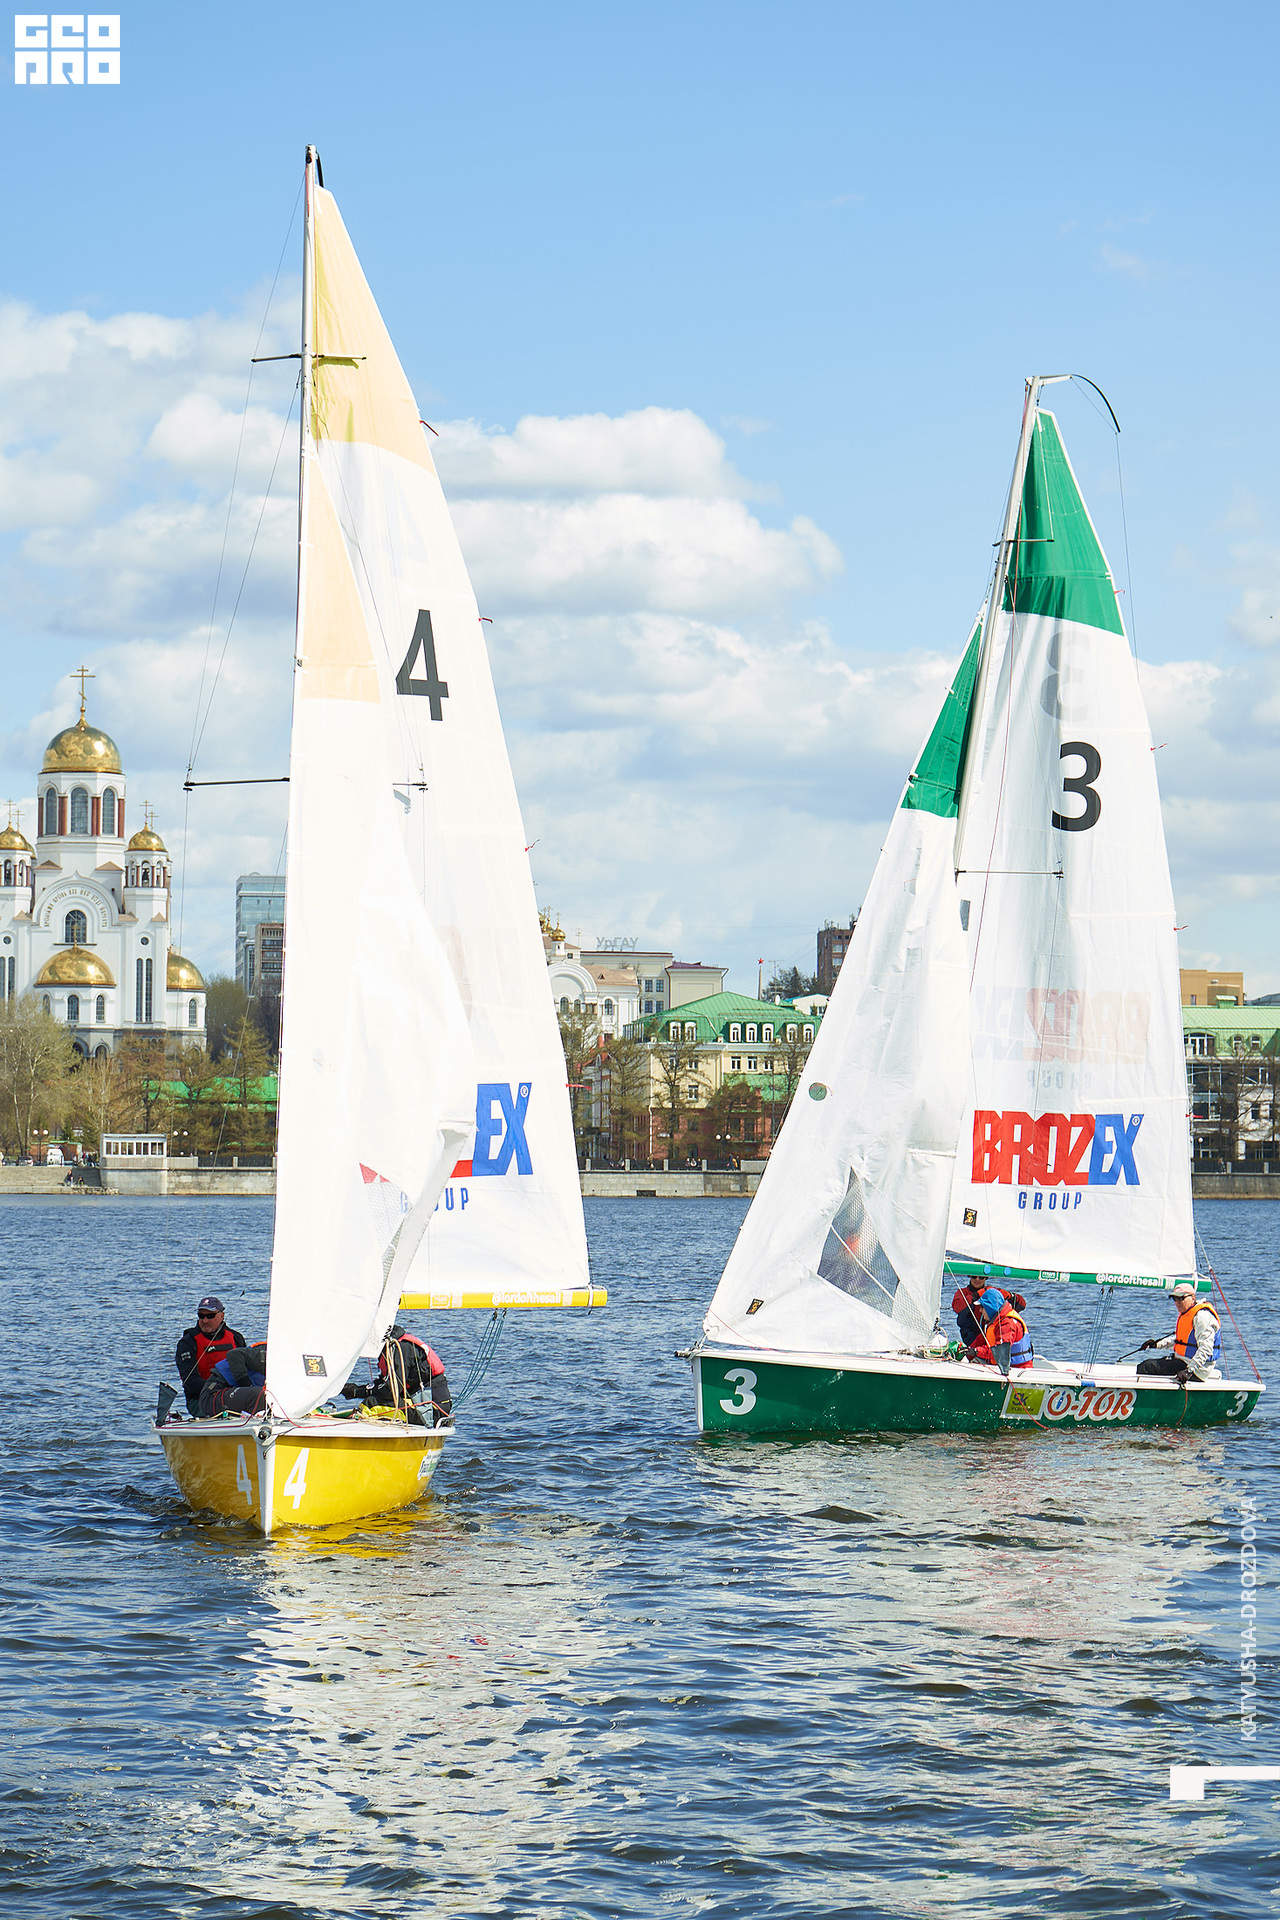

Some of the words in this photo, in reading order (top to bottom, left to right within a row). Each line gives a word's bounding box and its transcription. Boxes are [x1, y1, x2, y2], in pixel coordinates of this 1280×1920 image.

[395, 609, 449, 721] 4
[1051, 741, 1102, 832] 3
[596, 937, 639, 950] УрГАУ
[971, 1110, 1145, 1186] BROZEX
[1018, 1192, 1082, 1210] GROUP
[492, 1292, 561, 1306] @lordofthesail
[1096, 1273, 1163, 1287] @lordofthesail
[720, 1368, 757, 1415] 3
[1226, 1391, 1248, 1417] 3
[236, 1444, 252, 1505] 4
[283, 1448, 310, 1509] 4
